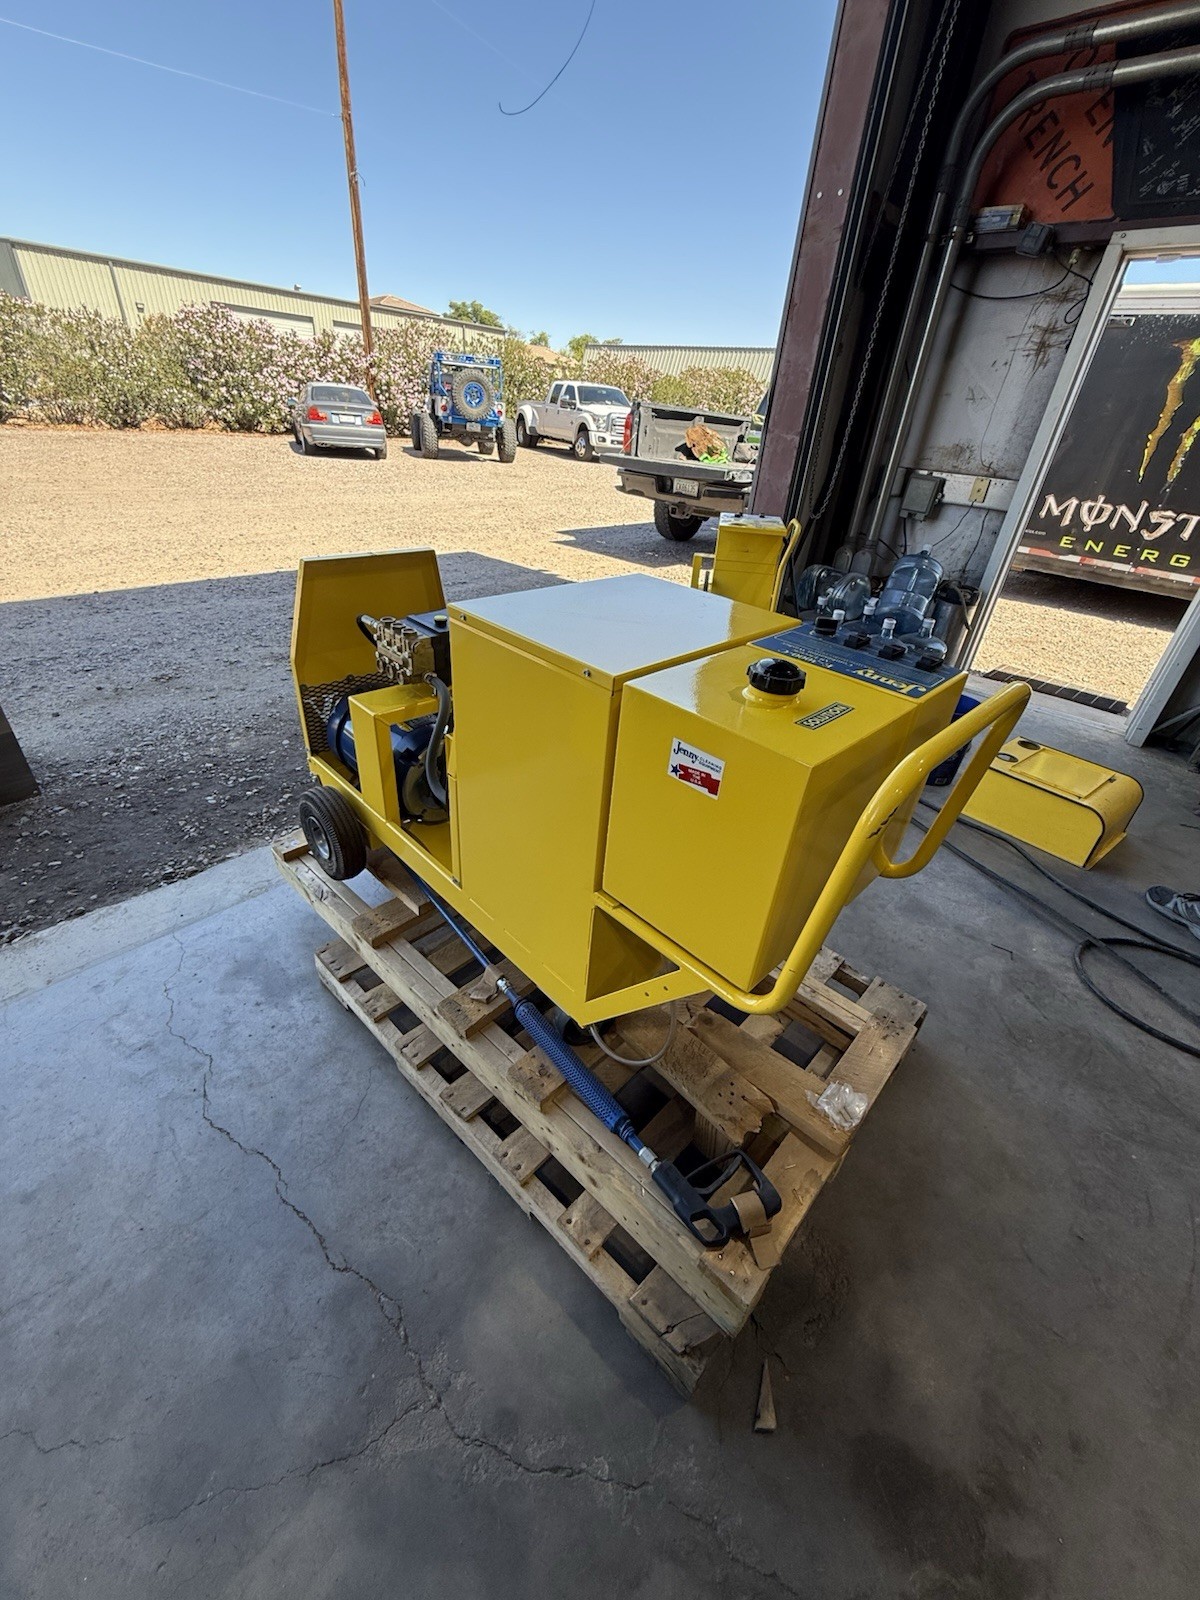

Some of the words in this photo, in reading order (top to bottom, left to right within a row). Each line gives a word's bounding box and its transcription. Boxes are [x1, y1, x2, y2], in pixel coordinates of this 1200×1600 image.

[1059, 535, 1192, 568] ENERG
[853, 666, 927, 694] Jenny
[802, 704, 849, 726] SOLUTION
[673, 741, 699, 764] Jenny
